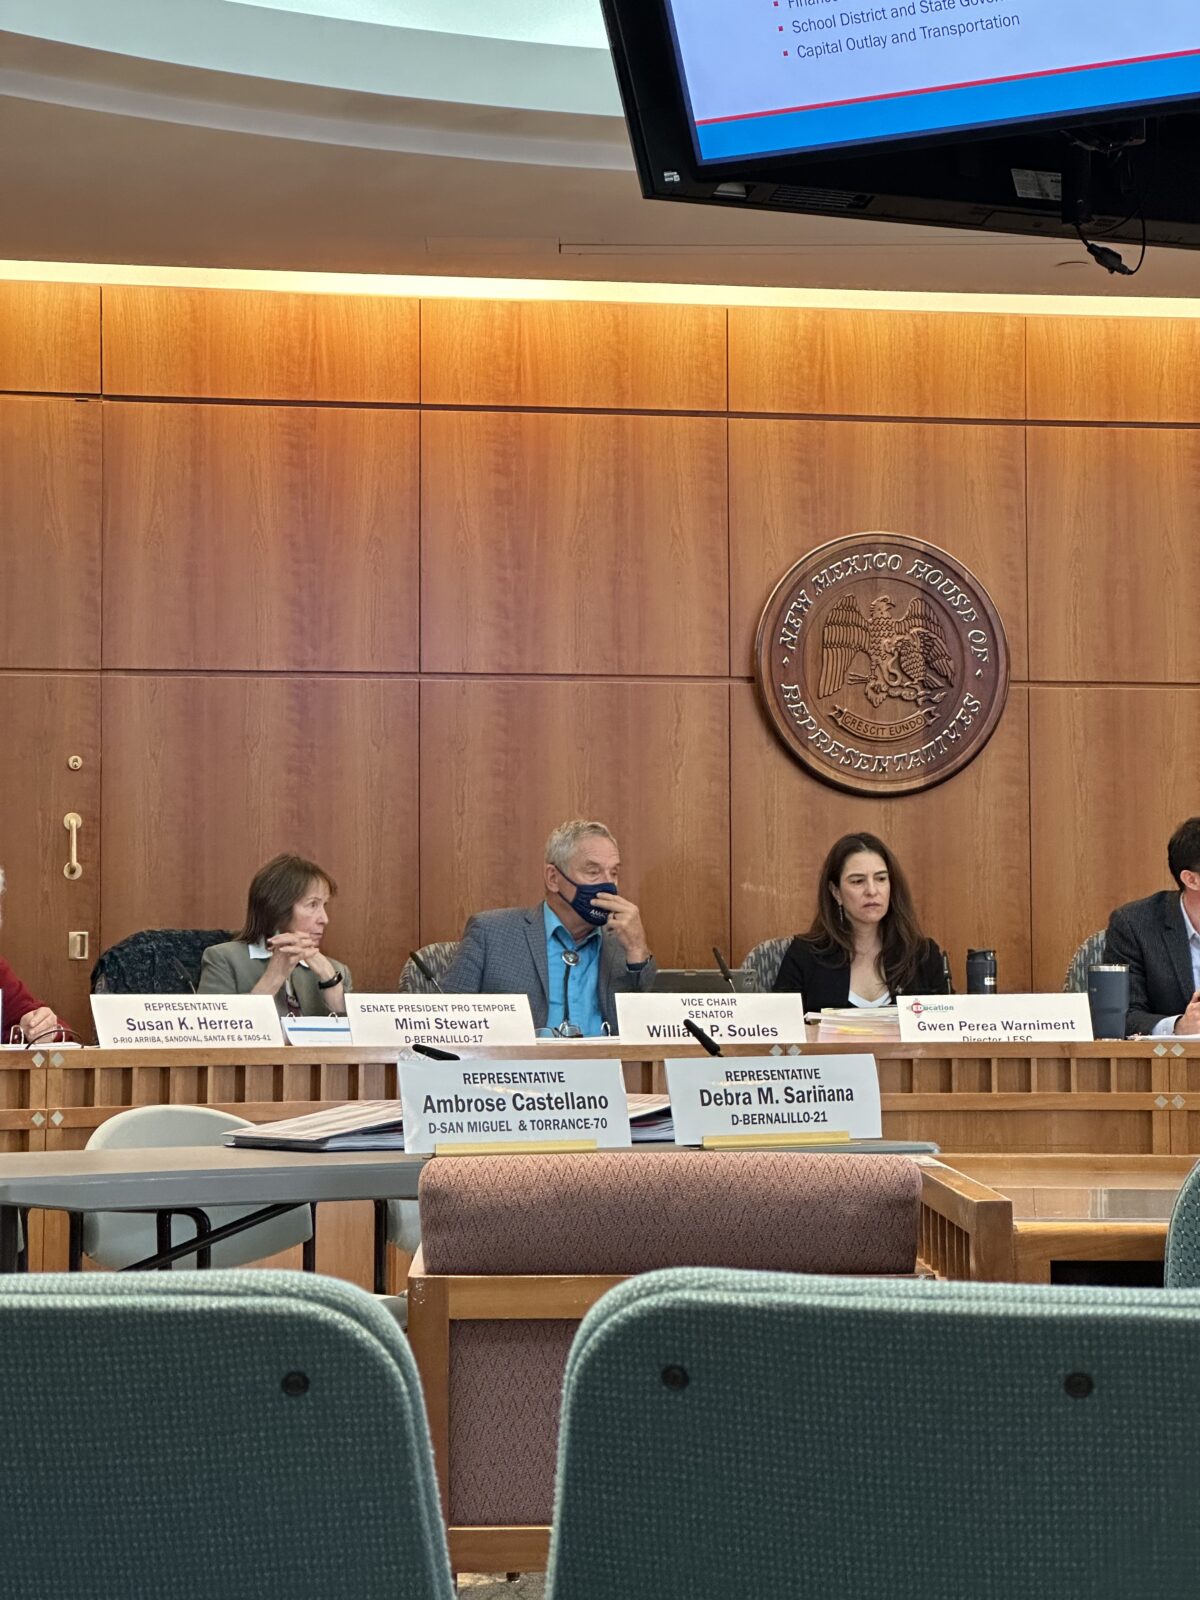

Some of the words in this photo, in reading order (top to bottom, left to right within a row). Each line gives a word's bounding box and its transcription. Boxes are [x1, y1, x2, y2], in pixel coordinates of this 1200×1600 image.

[788, 0, 838, 8] Fina
[792, 15, 836, 33] School
[840, 7, 888, 26] District
[890, 2, 917, 18] and
[920, 0, 956, 14] State
[797, 40, 843, 59] Capital
[846, 35, 887, 51] Outlay
[891, 28, 917, 44] and
[919, 14, 1021, 39] Transportation
[780, 590, 813, 651] NEW
[812, 553, 903, 595] MEXICO
[906, 559, 978, 622] HOUSE
[968, 629, 989, 664] OF
[781, 683, 981, 773] REPRESENTATIVES
[844, 715, 886, 736] CRESCIT
[889, 717, 923, 736] EUNDO
[144, 1002, 229, 1012] REPRESENTATIVE
[360, 1004, 396, 1013] SENATE
[398, 1004, 448, 1012] PRESIDENT
[451, 1004, 470, 1012] PRO
[472, 1004, 517, 1012] TEMPORE
[681, 998, 704, 1007] VICE
[706, 998, 737, 1007] CHAIR
[688, 1010, 734, 1019] SENATOR
[126, 1017, 173, 1031] Susan
[178, 1017, 194, 1030] K.
[197, 1016, 254, 1030] Herrera
[394, 1017, 431, 1030] Mimi
[434, 1017, 490, 1030] Stewart
[917, 1020, 954, 1032] Gwen
[959, 1020, 997, 1032] Perea
[1000, 1019, 1076, 1031] Warniment
[647, 1024, 703, 1038] Willia
[710, 1024, 723, 1037] P.
[727, 1024, 779, 1037] Soules
[113, 1036, 133, 1044] D-RIO
[134, 1036, 164, 1044] ARRIBA,
[165, 1035, 203, 1043] SANDOVAL,
[203, 1034, 226, 1042] SANTA
[227, 1034, 236, 1042] FE
[237, 1034, 243, 1042] &
[244, 1034, 272, 1042] TAOS-41
[404, 1034, 483, 1044] D-BERNALILLO-17
[463, 1071, 566, 1085] REPRESENTATIVE
[725, 1068, 821, 1082] REPRESENTATIVE
[423, 1094, 506, 1114] Ambrose
[512, 1092, 609, 1112] Castellano
[699, 1088, 752, 1107] Debra
[757, 1087, 779, 1105] M.
[784, 1085, 854, 1103] Sariñana
[428, 1122, 464, 1134] D-SAN
[467, 1120, 512, 1133] MIGUEL
[518, 1119, 528, 1132] &
[529, 1117, 608, 1132] TORRANCE-70
[731, 1111, 828, 1126] D-BERNALILLO-21
